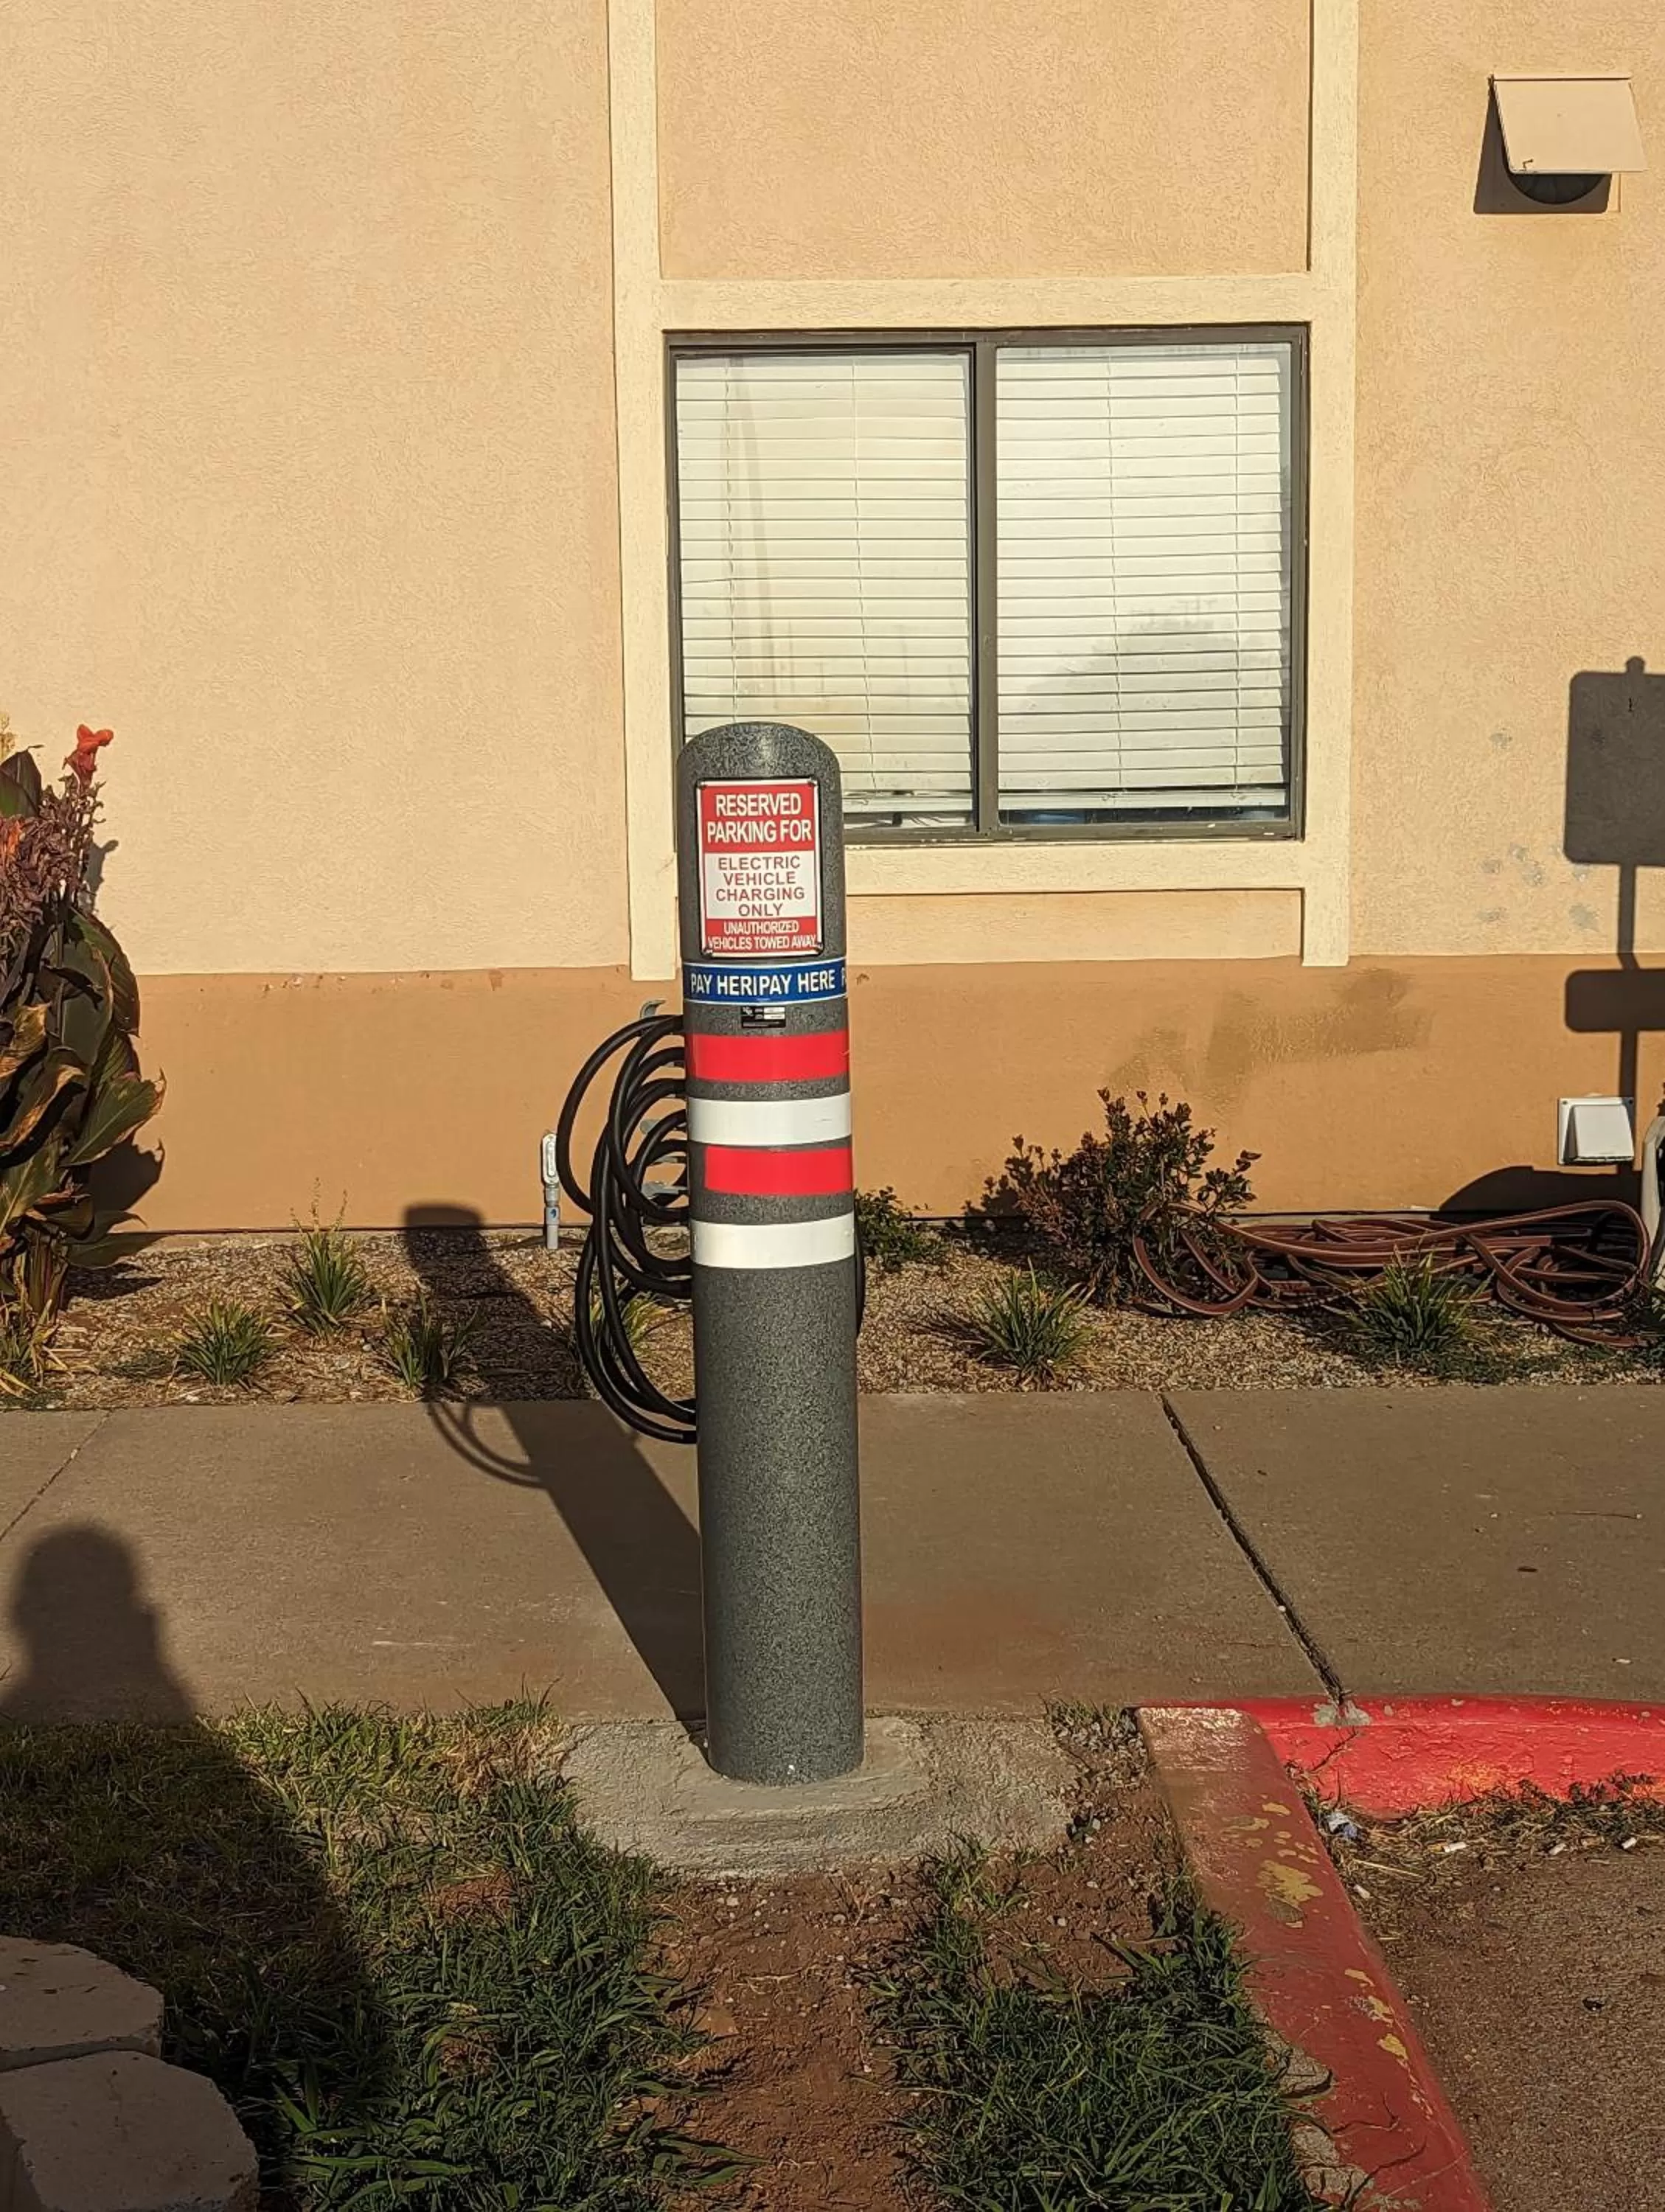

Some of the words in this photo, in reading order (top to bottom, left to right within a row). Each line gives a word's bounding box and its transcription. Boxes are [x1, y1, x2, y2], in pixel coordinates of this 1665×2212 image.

[715, 793, 802, 817] RESERVED
[707, 821, 776, 844] PARKING
[780, 819, 812, 842] FOR
[718, 855, 801, 871] ELECTRIC
[723, 872, 796, 886] VEHICLE
[716, 887, 804, 902] CHARGING
[738, 903, 784, 917] ONLY
[723, 920, 799, 935] UNAUTHORIZED
[708, 936, 752, 950] VEHICLES
[754, 935, 790, 949] TOWED
[792, 934, 816, 947] AWAY
[690, 973, 712, 995] PAY
[759, 974, 793, 995] PAY
[797, 969, 835, 993] HERE
